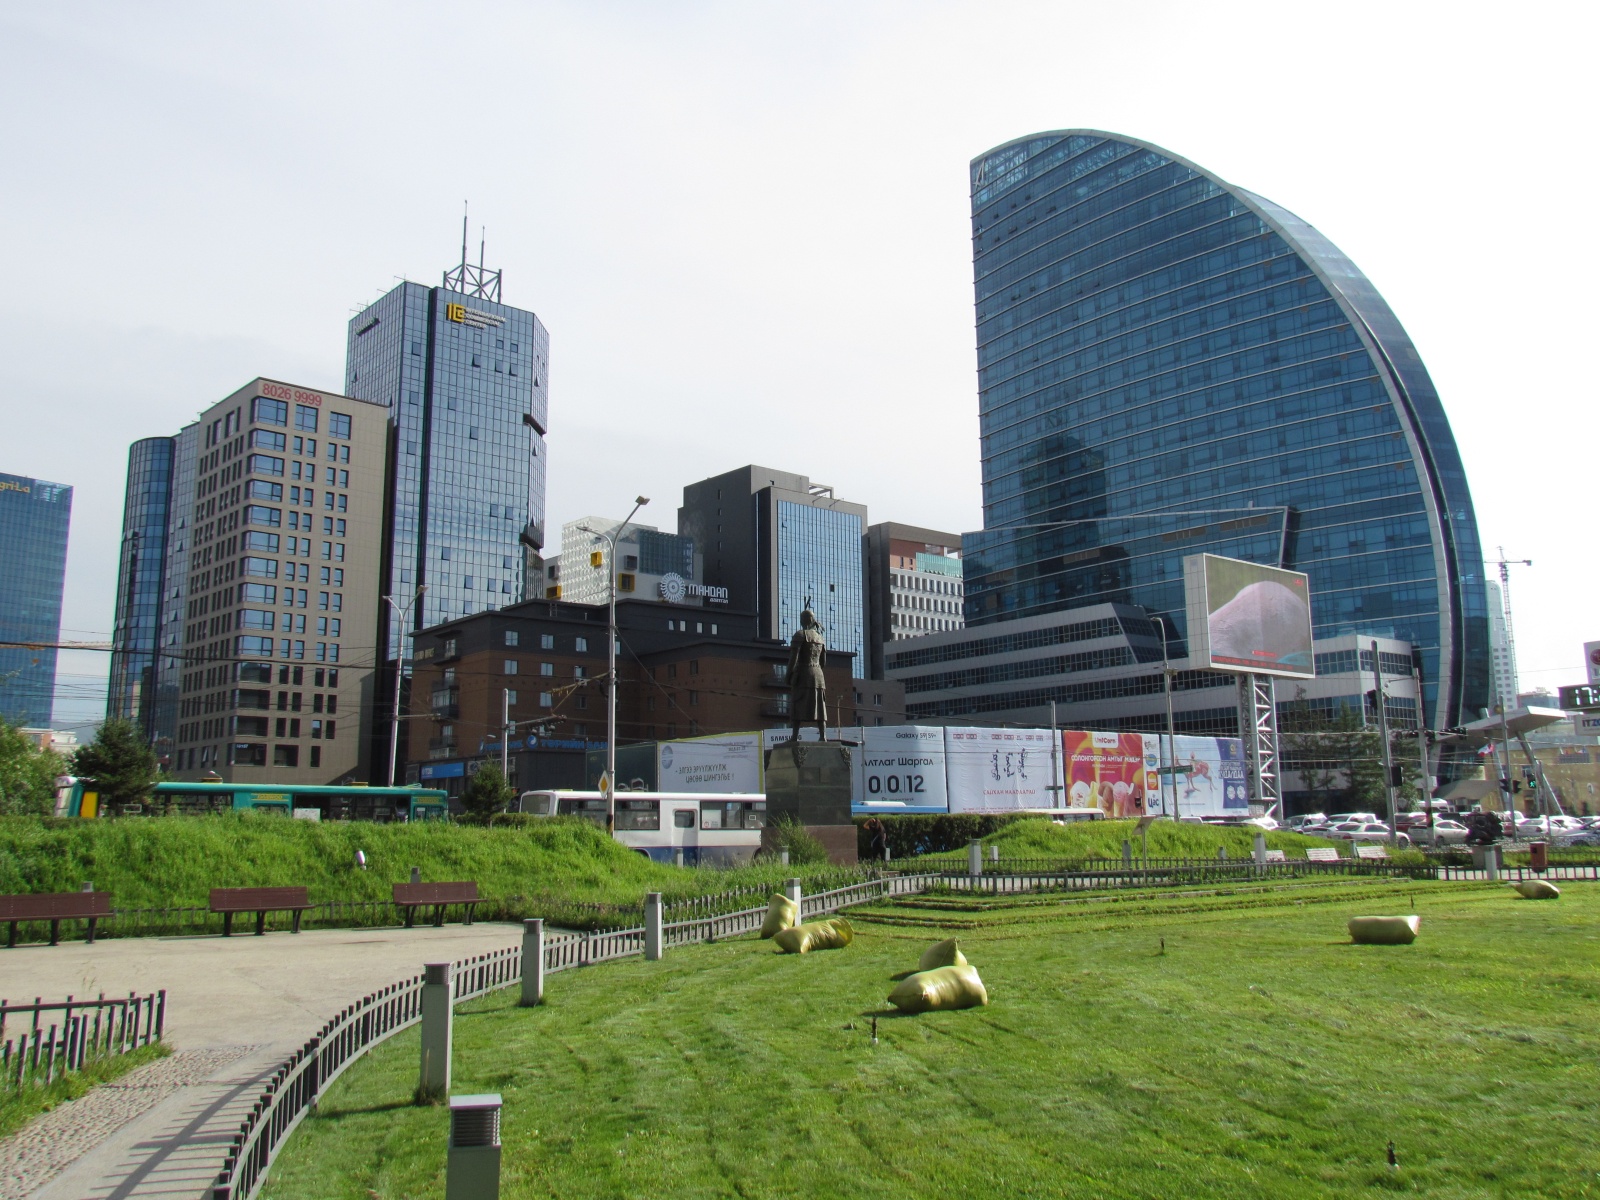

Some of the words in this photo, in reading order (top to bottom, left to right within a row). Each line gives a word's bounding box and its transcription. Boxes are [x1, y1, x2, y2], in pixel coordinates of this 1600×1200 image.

[263, 383, 291, 400] 8026
[294, 390, 322, 406] 9999
[896, 732, 919, 740] Galaxy
